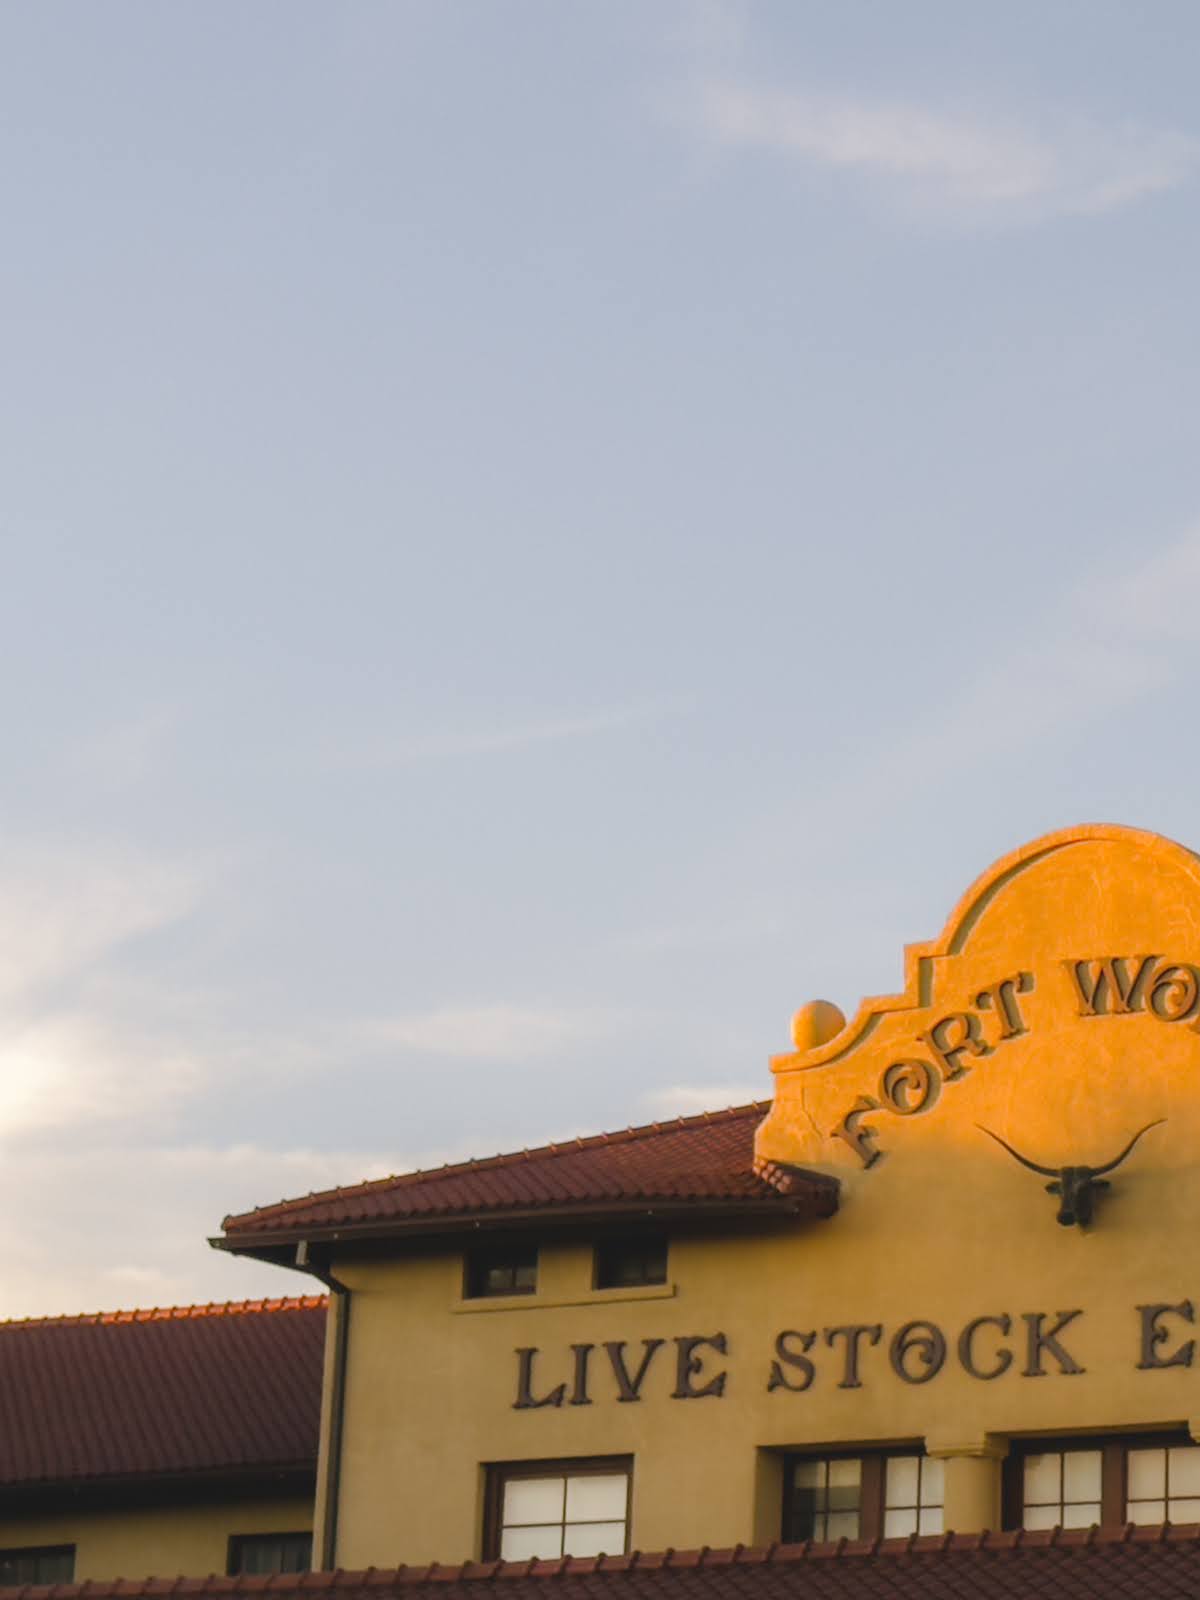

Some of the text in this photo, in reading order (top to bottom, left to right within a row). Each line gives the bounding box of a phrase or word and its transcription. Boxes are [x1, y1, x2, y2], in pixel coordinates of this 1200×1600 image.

[830, 970, 1035, 1170] FORT
[511, 1331, 729, 1410] LIVE
[767, 1308, 1087, 1393] STOCK
